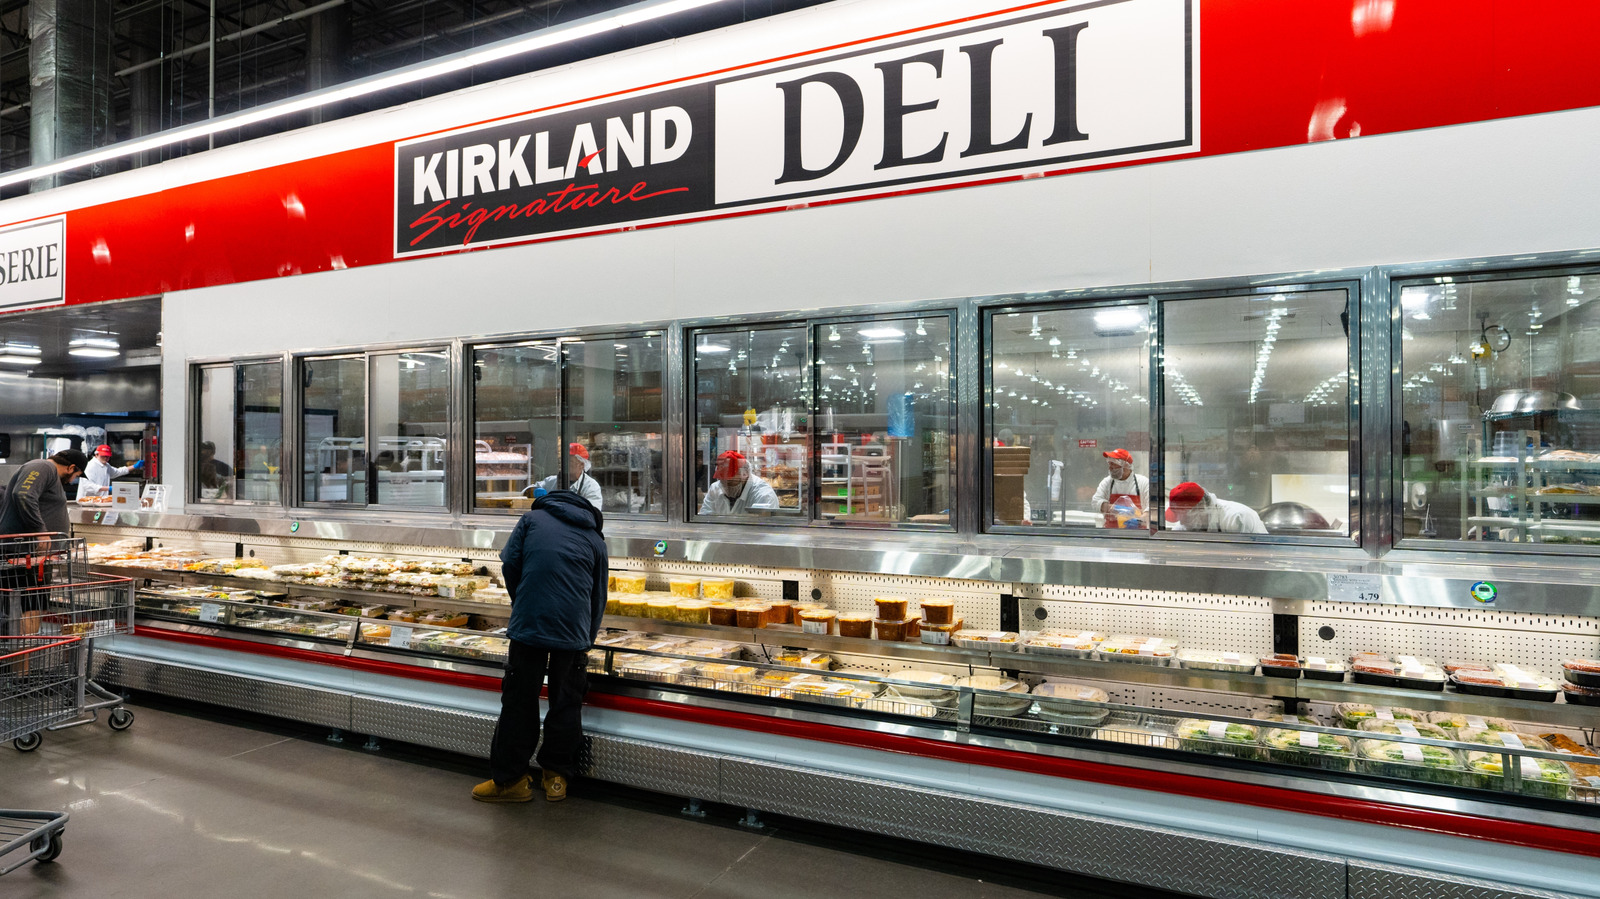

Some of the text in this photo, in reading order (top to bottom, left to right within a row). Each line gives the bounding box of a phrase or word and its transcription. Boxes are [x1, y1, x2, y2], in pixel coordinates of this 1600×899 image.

[774, 20, 1090, 186] DELI
[413, 105, 693, 206] KIRKLAND
[409, 181, 689, 247] Signature
[21, 470, 39, 490] SALT
[1358, 592, 1379, 600] 4.79
